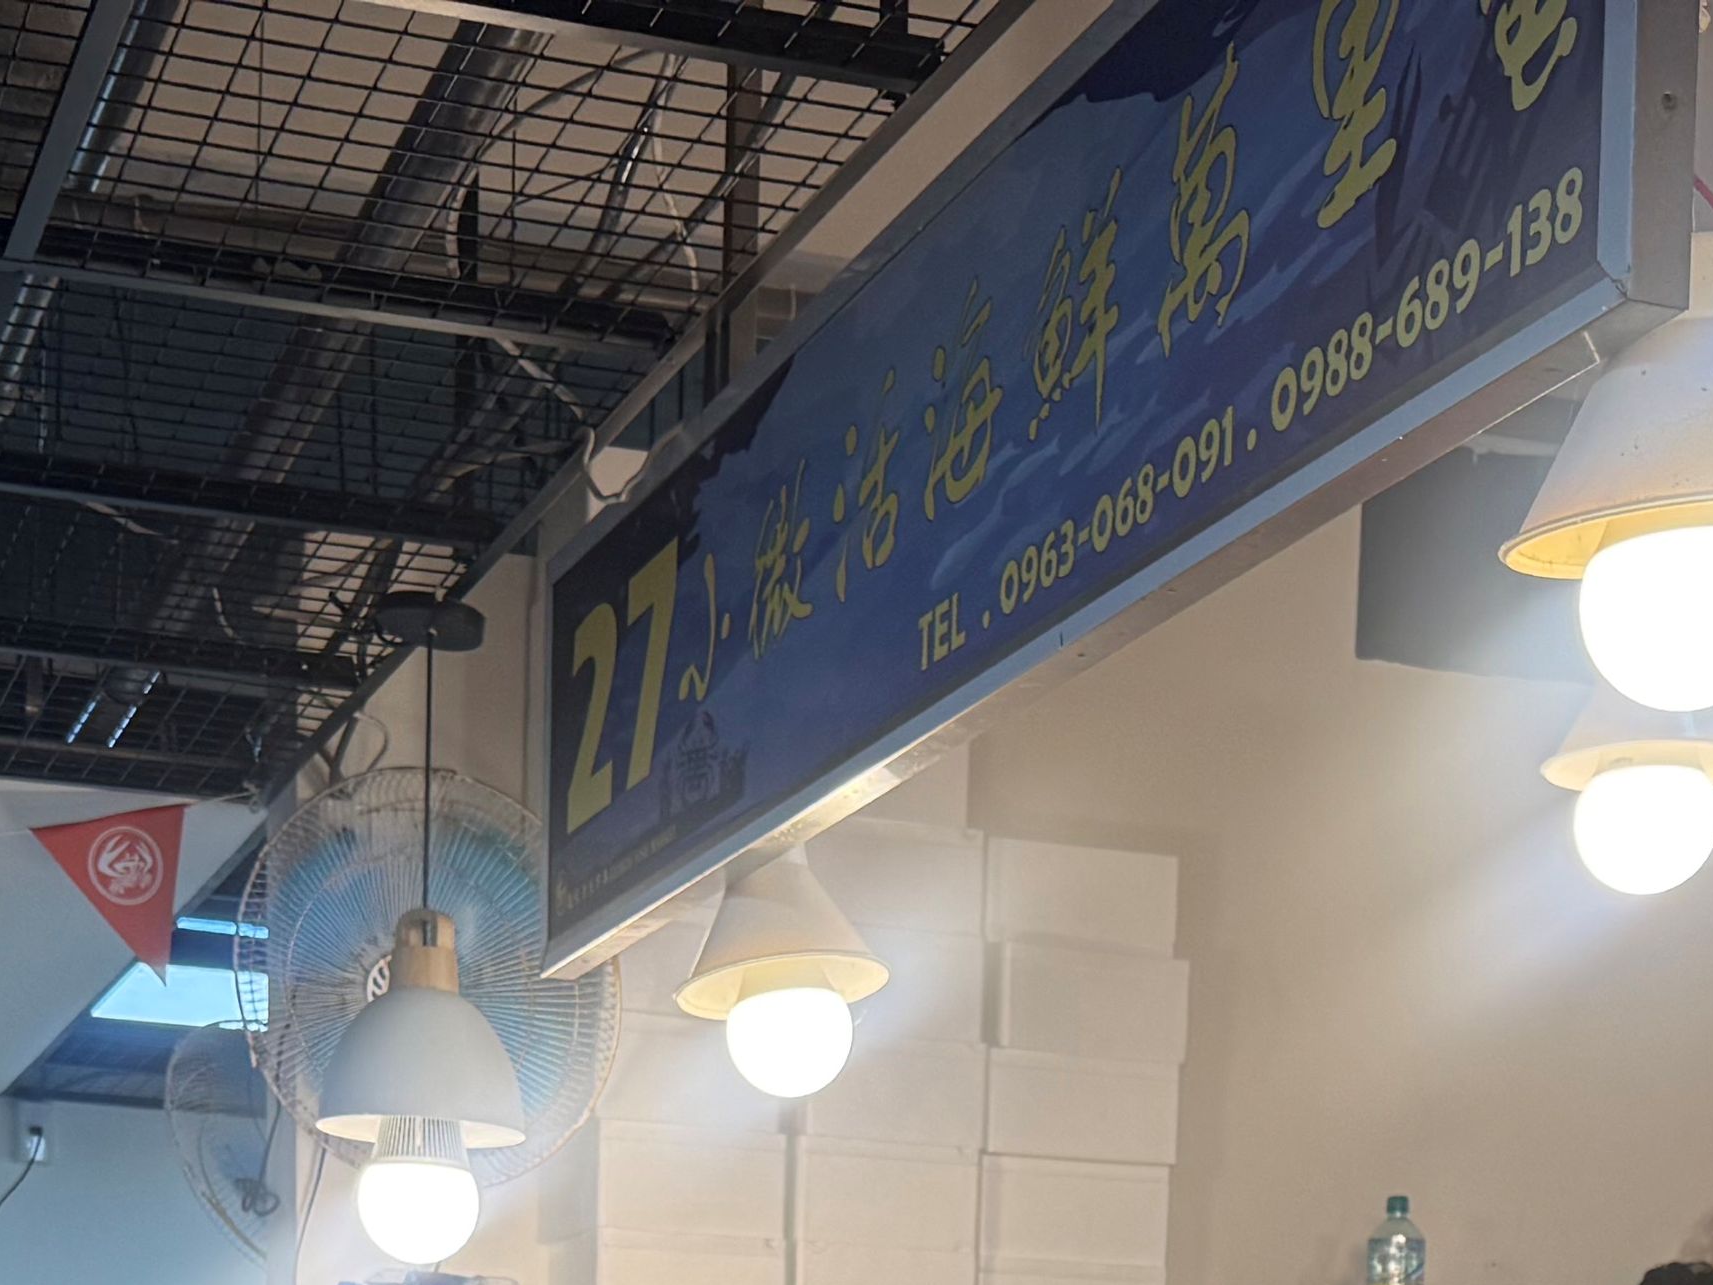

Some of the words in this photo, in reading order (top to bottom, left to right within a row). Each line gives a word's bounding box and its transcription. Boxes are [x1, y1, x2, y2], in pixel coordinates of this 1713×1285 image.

[999, 405, 1236, 616] 0963-068-091
[1270, 166, 1584, 433] 0988-689-138
[566, 535, 679, 835] 27
